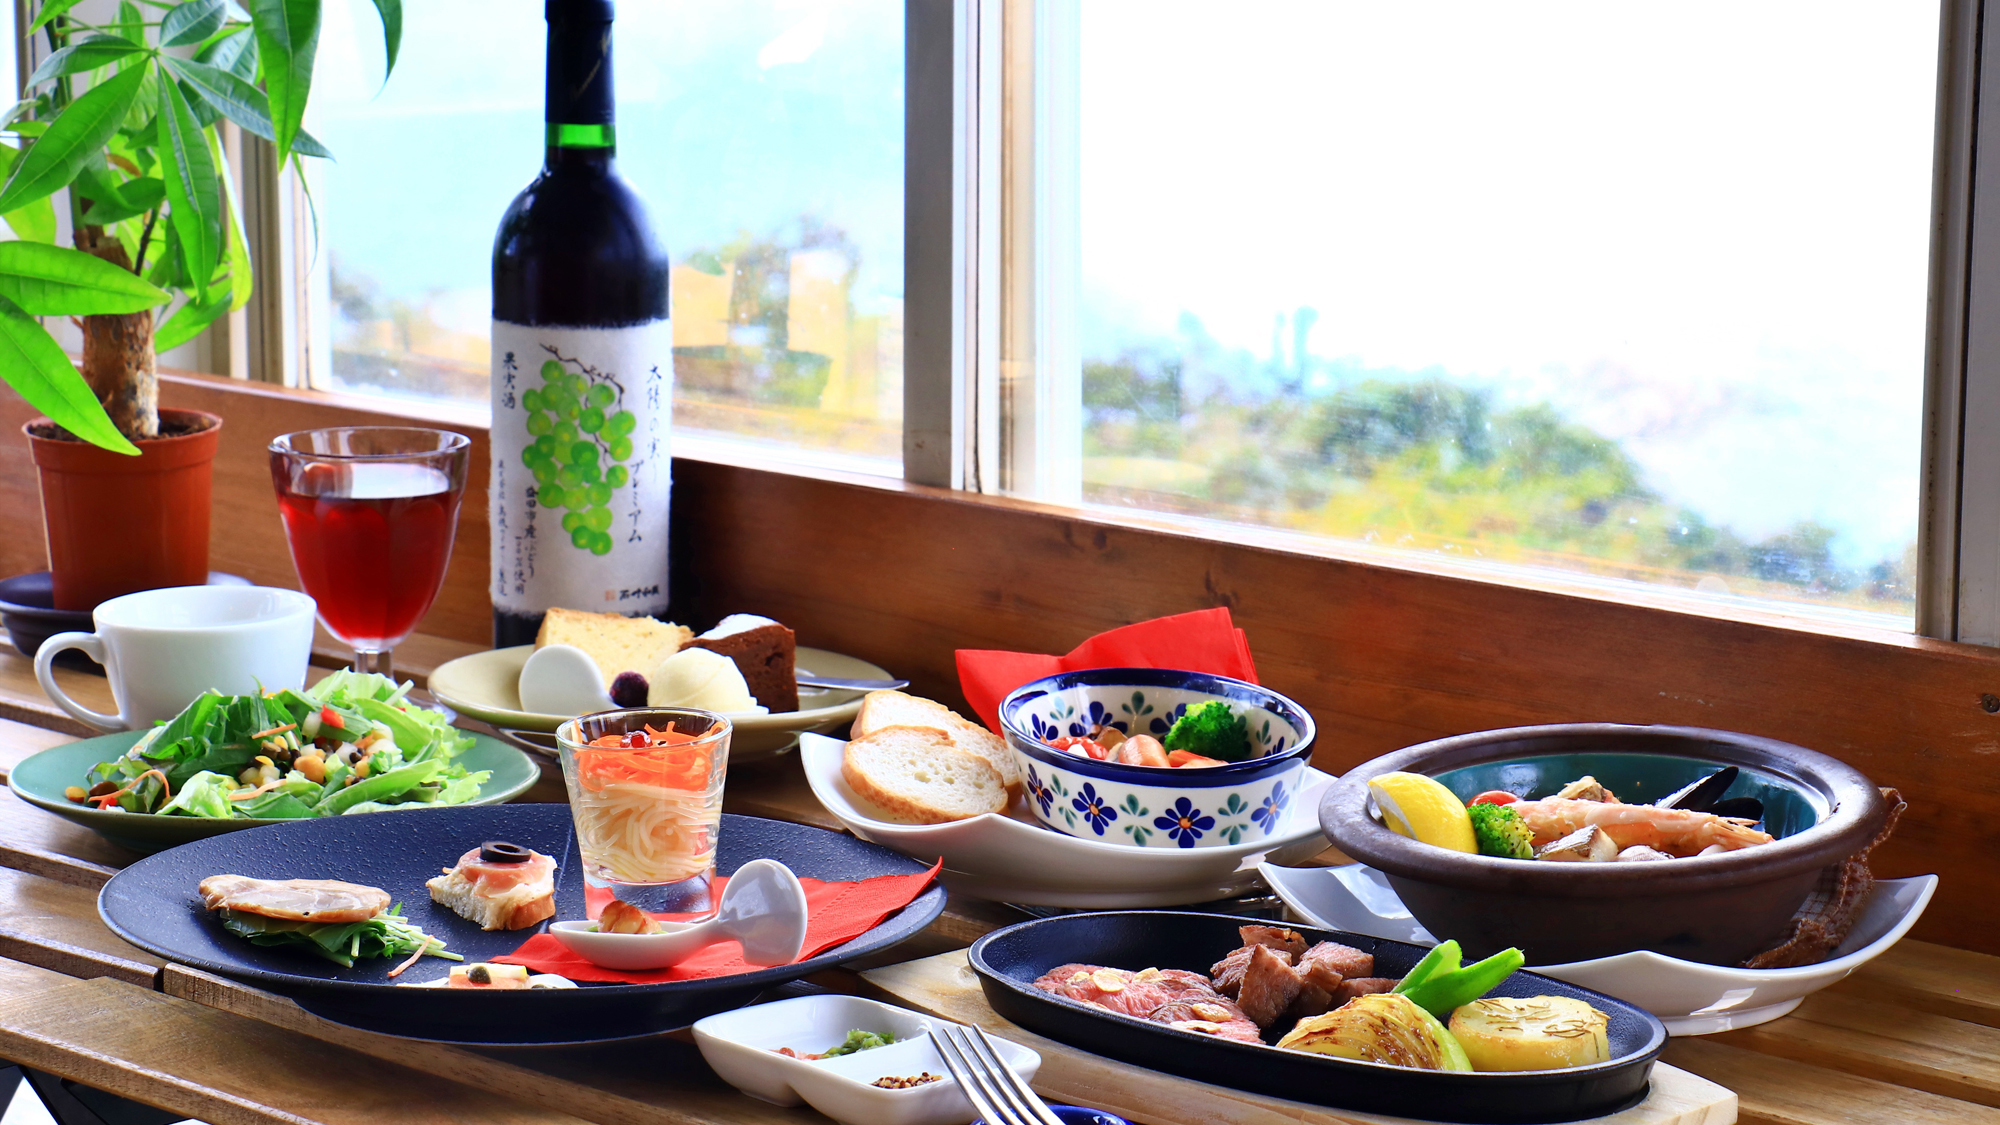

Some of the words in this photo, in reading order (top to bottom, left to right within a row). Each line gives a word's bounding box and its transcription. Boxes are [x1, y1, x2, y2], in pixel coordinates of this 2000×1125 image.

[501, 351, 518, 410] 果実酒
[628, 459, 644, 543] プレミアム
